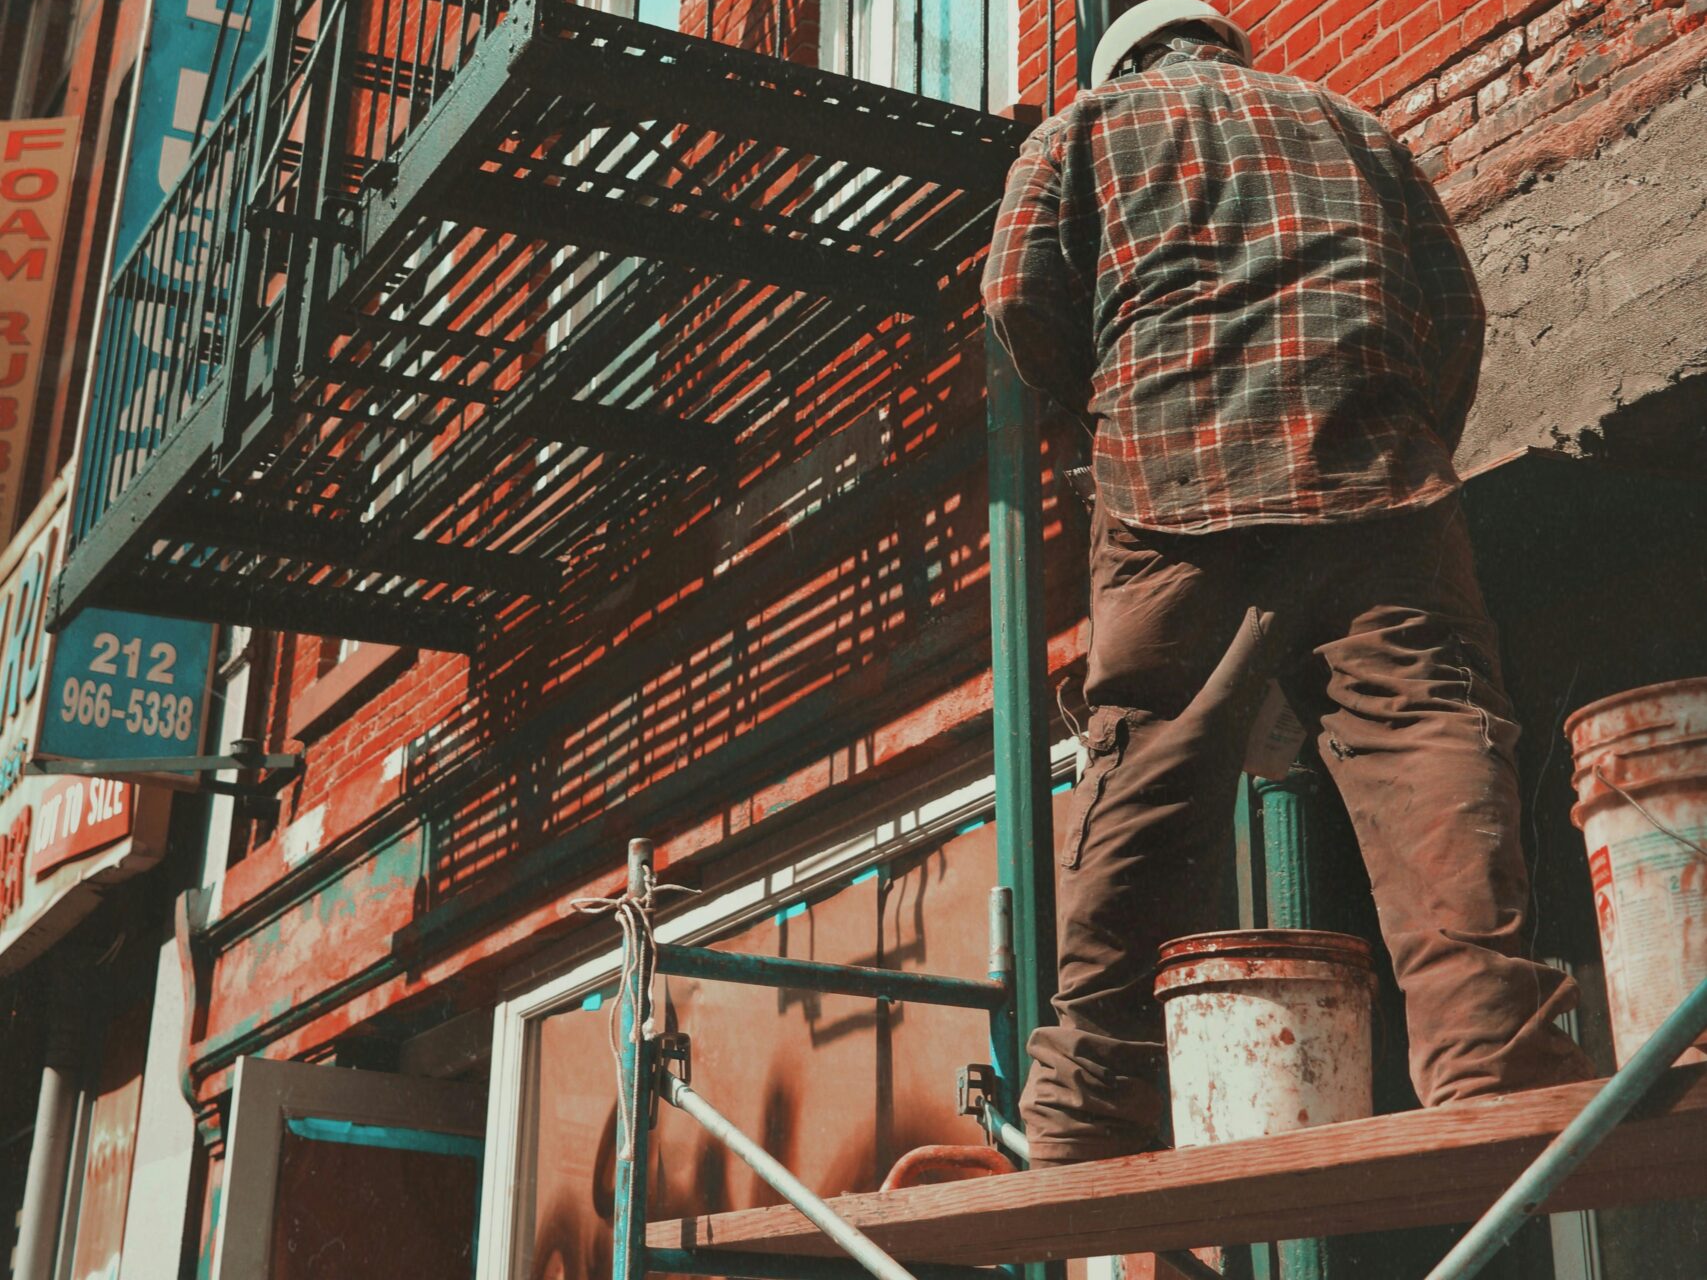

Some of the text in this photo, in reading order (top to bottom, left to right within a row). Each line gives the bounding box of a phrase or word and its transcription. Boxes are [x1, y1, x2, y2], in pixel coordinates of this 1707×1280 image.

[0, 128, 66, 282] FOAM
[89, 632, 177, 685] 212
[61, 676, 193, 742] 966-5338
[87, 777, 124, 827] SIZE
